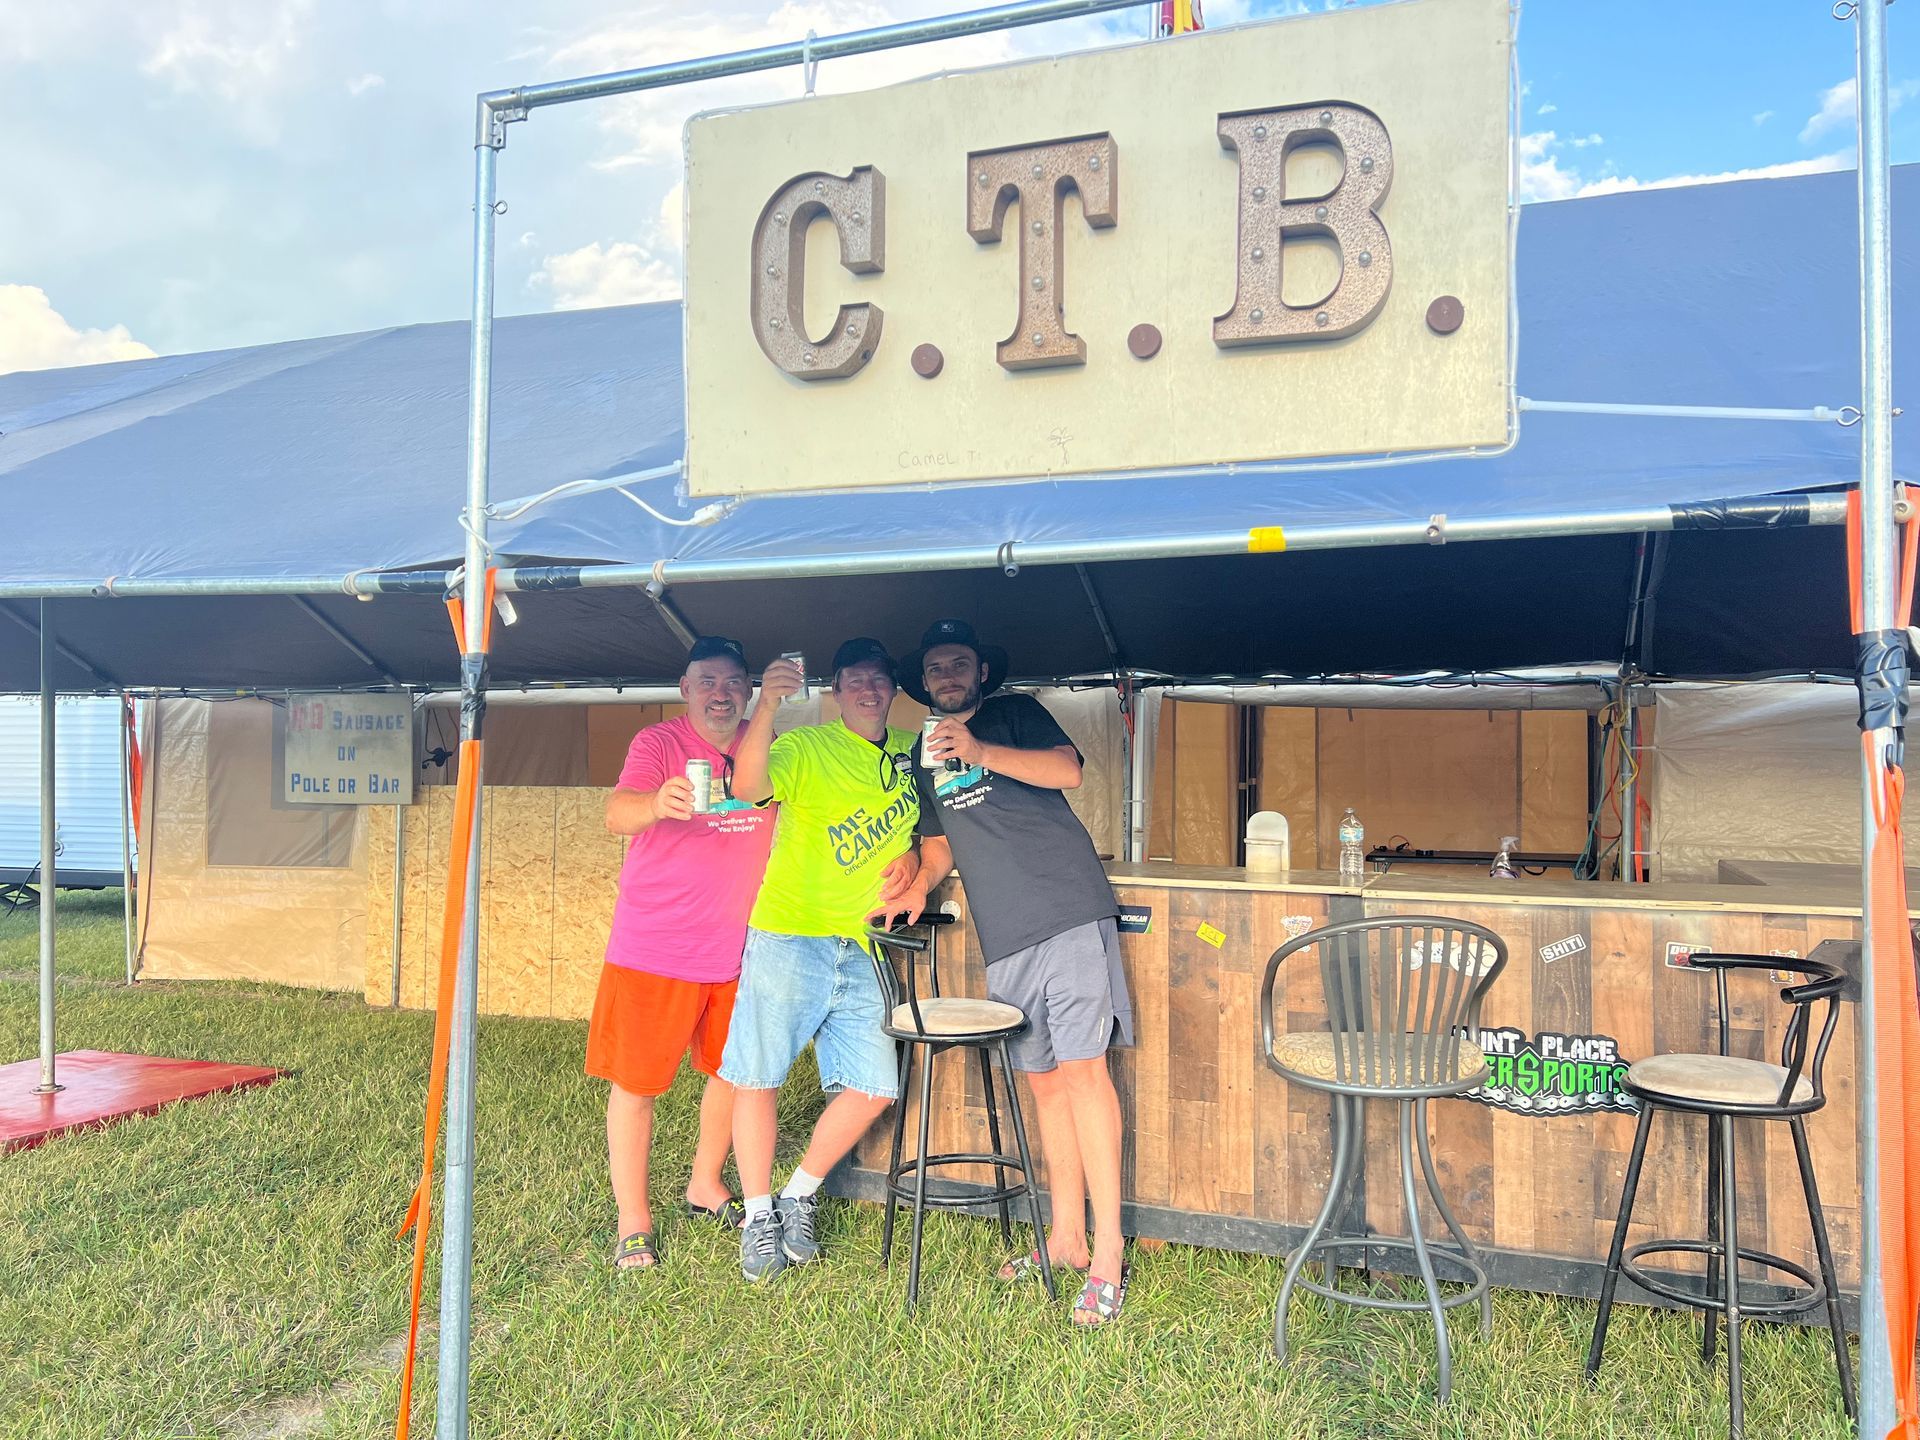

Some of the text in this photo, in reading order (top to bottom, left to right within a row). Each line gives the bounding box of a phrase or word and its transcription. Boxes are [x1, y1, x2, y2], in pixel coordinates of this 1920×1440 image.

[337, 746, 356, 761] ON
[291, 773, 400, 794] POLE OR BAR
[943, 799, 954, 807] We
[952, 802, 967, 811] You
[707, 820, 720, 828] We
[844, 857, 869, 876] Official
[868, 849, 878, 860] RV
[1541, 1035, 1616, 1062] PLACE
